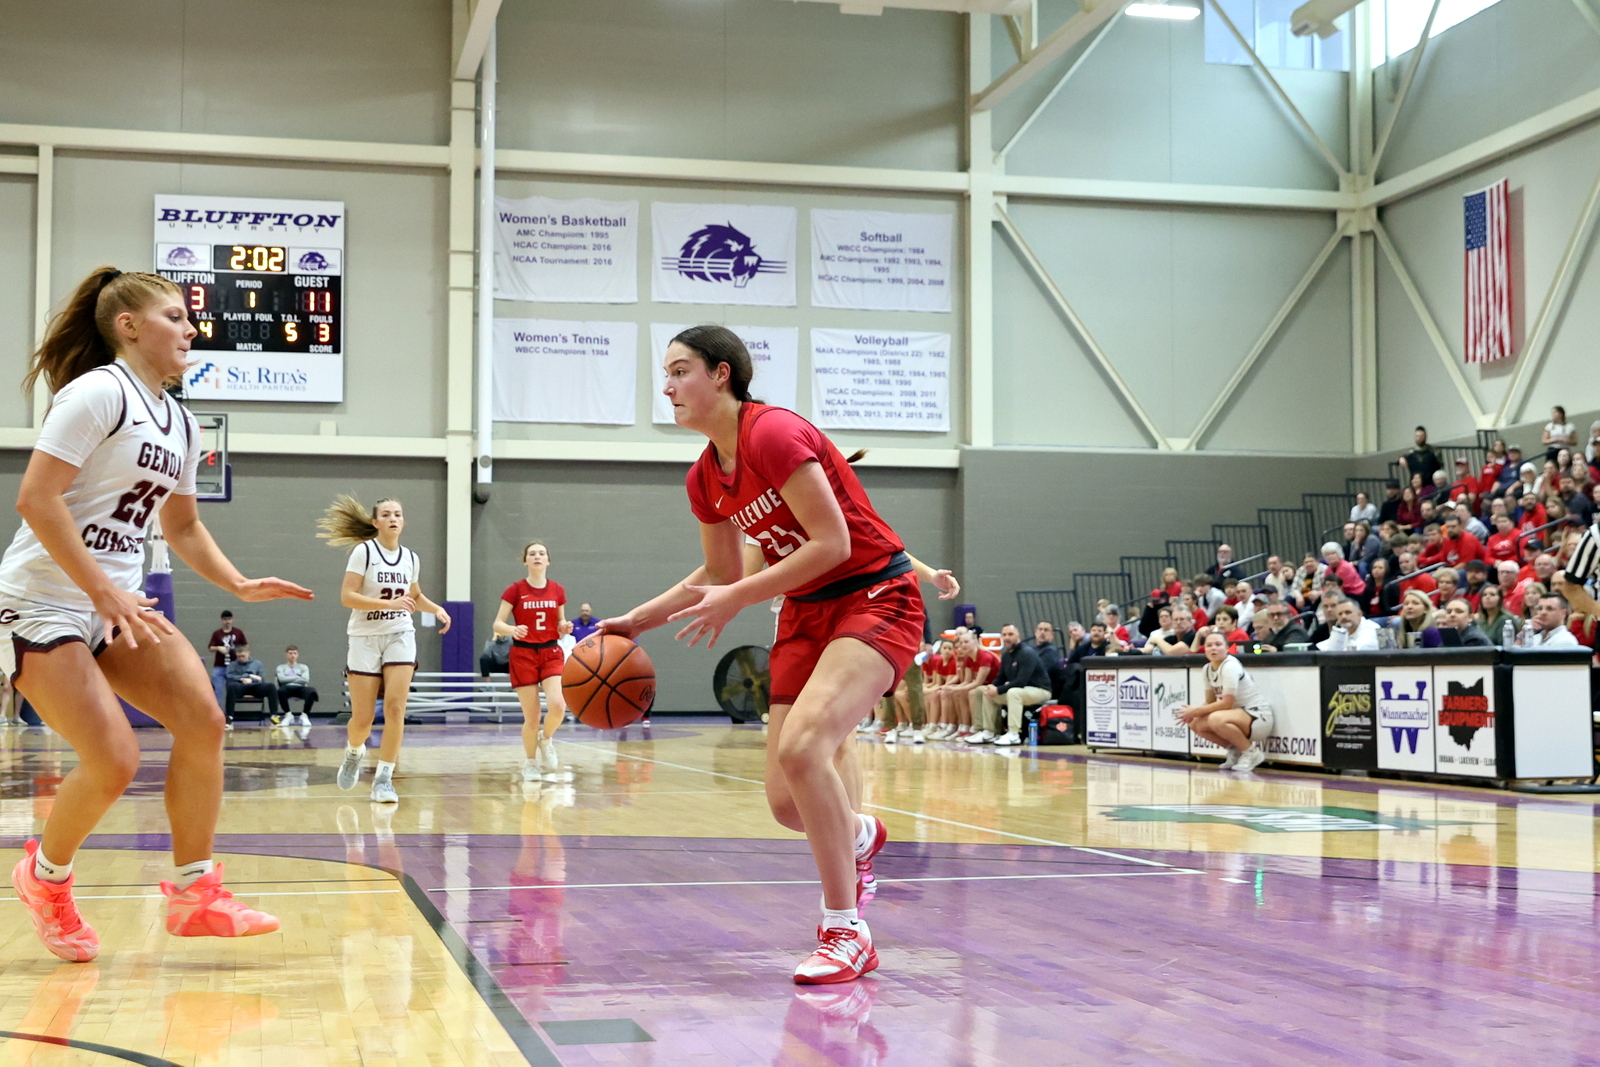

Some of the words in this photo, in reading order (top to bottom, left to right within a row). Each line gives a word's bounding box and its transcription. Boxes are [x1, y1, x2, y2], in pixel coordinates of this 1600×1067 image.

[158, 208, 341, 228] BLUFFTON
[500, 212, 557, 226] Women's
[562, 215, 626, 227] Basketball
[169, 222, 321, 233] UNIVERSITY
[516, 229, 536, 237] AMC
[538, 230, 587, 239] Champions:
[860, 231, 902, 242] Softball
[513, 241, 538, 249] HCAC
[541, 242, 590, 251] Champions:
[230, 246, 284, 272] 2:02
[513, 255, 537, 263] NCAA
[235, 279, 263, 289] PERIOD
[294, 275, 330, 288] GUEST
[191, 286, 204, 310] 3
[250, 291, 256, 308] 1
[308, 291, 331, 312] 11
[223, 312, 251, 322] PLAYER
[255, 313, 274, 322] FOUL
[281, 314, 301, 323] T.O.L.
[309, 315, 333, 324] FOULS
[200, 322, 213, 338] 4
[318, 323, 330, 342] 3
[514, 332, 568, 344] Women's
[572, 334, 610, 345] Tennis
[855, 335, 908, 347] Volleyball
[236, 343, 263, 351] MATCH
[309, 345, 333, 353] SCORE
[515, 346, 540, 354] WBCC
[836, 348, 878, 356] Champions
[227, 367, 250, 383] ST.
[258, 367, 307, 384] RITA'S
[137, 441, 182, 481] GENOA
[109, 480, 171, 530] 25
[377, 571, 408, 585] GENOA
[523, 599, 557, 609] BELLEVUE
[0, 608, 20, 624] G
[535, 611, 546, 631] 2
[1119, 685, 1149, 700] STOLLY
[1442, 695, 1488, 711] FARMERS
